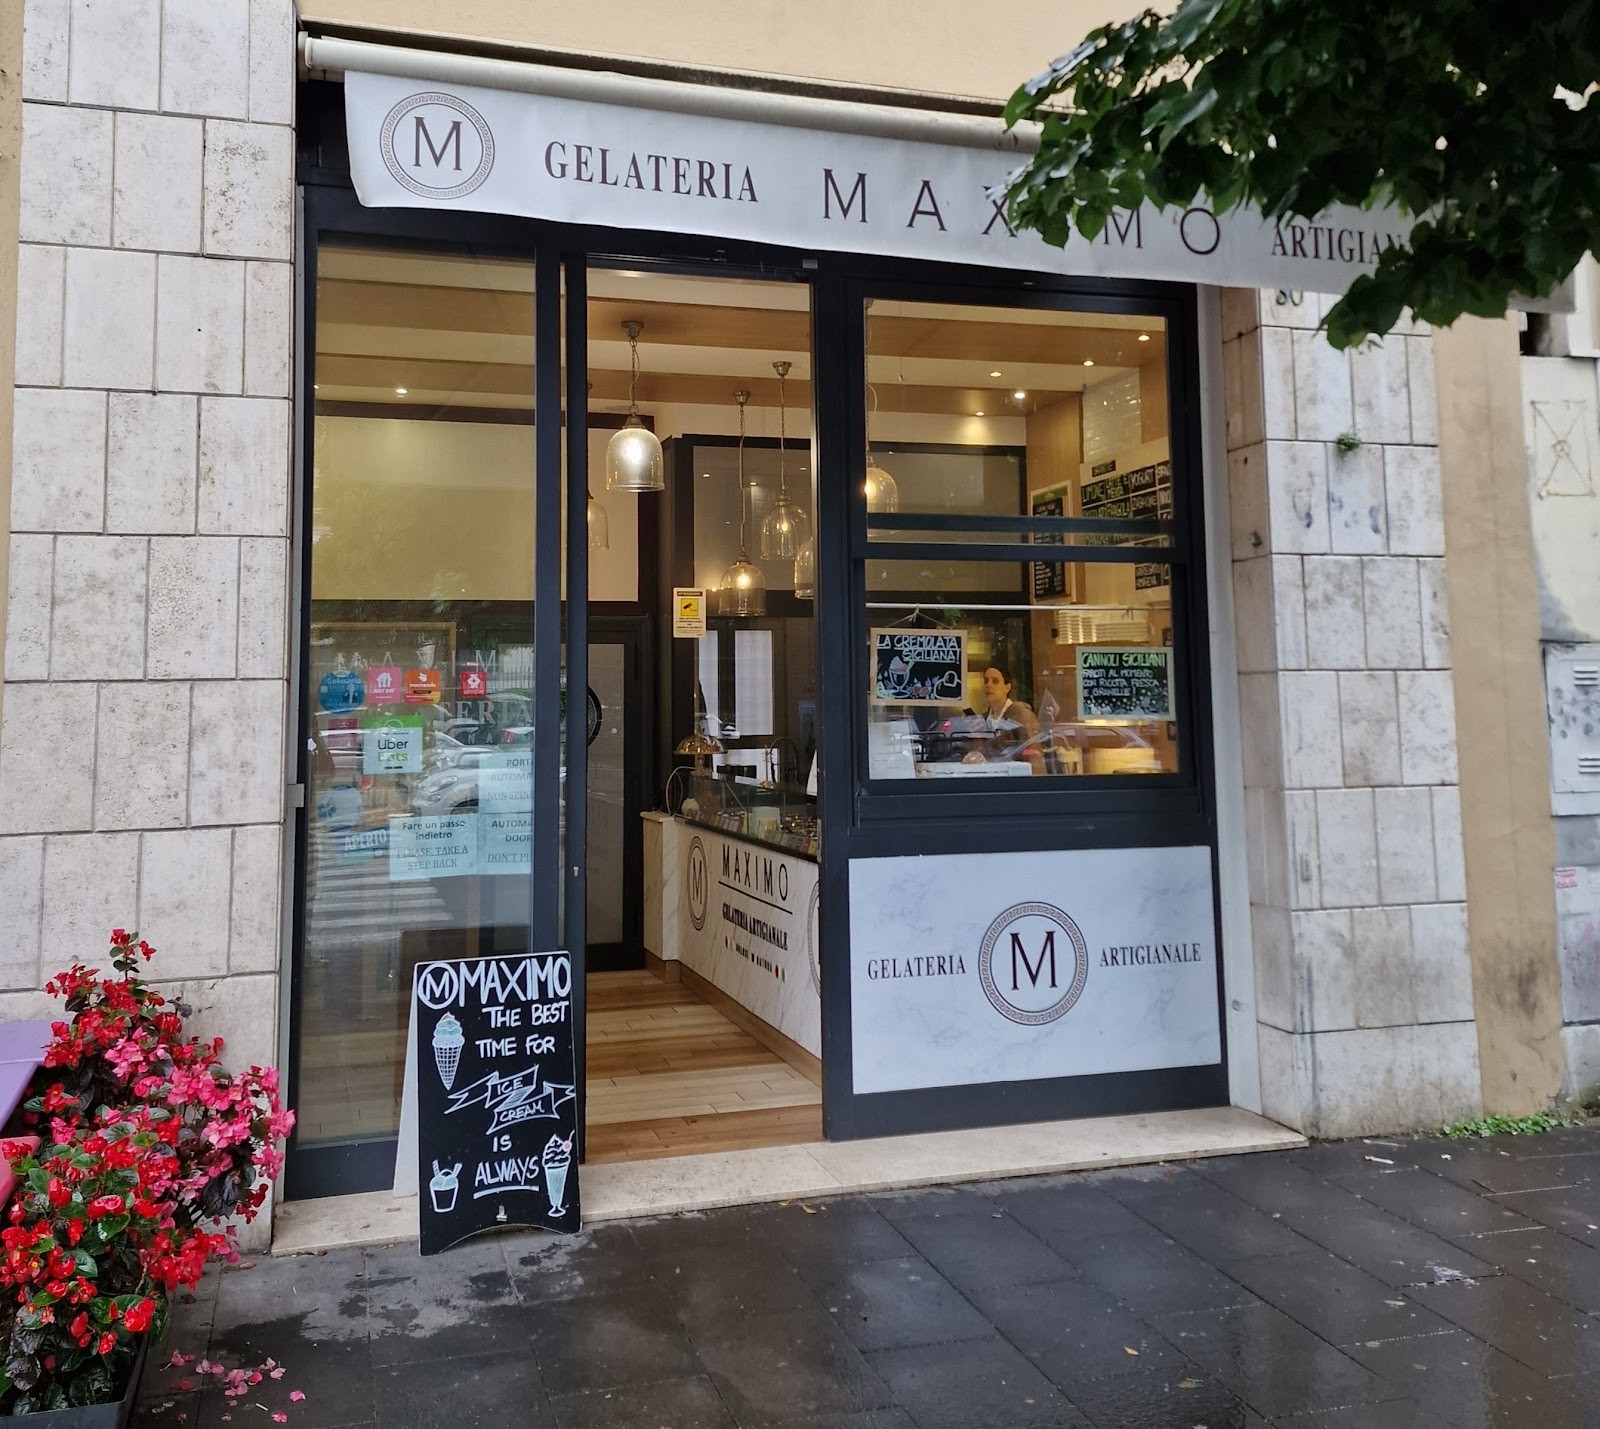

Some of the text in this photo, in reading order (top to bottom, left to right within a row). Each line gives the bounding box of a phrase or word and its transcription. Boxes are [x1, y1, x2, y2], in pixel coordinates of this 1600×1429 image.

[413, 116, 462, 171] M
[544, 140, 1401, 265] GELATERIA MAXMO ARTIGIAN
[877, 635, 958, 649] LA CREMOLATA
[377, 739, 408, 750] Uber
[377, 751, 408, 762] Eats
[506, 759, 532, 767] PORT
[490, 772, 533, 782] AUTOMA
[509, 791, 531, 800] SPIN
[403, 822, 423, 831] Fare
[440, 820, 466, 830] passo
[491, 820, 533, 829] AUTOMA
[344, 829, 387, 851] APERTO
[415, 831, 453, 841] indietro
[436, 846, 460, 856] TAKE
[408, 858, 458, 871] STEP BACK
[722, 843, 789, 902] MAXIMO
[692, 857, 703, 905] M
[867, 930, 1202, 991] GELATERIA M ARTIGIANALE
[425, 956, 572, 1008] M MAXIMO
[481, 1000, 570, 1029] THE BEST
[475, 1033, 556, 1059] TIME FOR
[497, 1077, 524, 1096] ICE
[499, 1100, 546, 1122] CREAM
[492, 1134, 513, 1153] IS
[474, 1156, 540, 1188] ALWAYS
